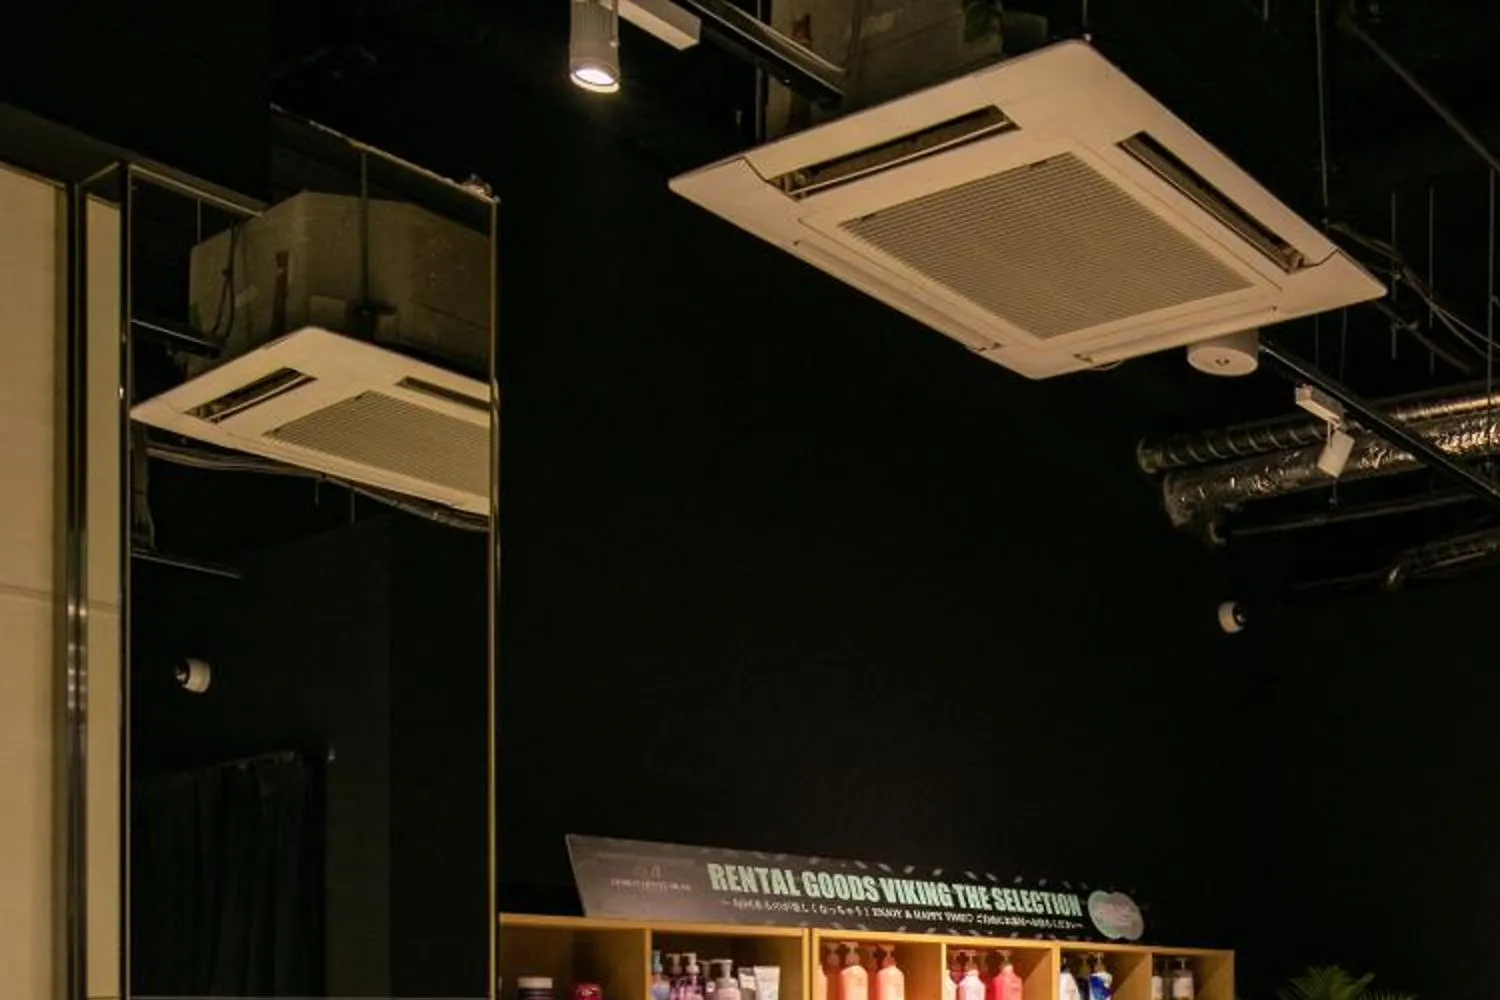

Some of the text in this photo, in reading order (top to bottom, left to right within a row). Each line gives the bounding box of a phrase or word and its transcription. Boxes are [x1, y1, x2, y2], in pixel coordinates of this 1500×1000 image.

[707, 863, 801, 897] RENTAL
[801, 870, 881, 903] GOODS
[878, 877, 954, 908] VIKING
[952, 883, 993, 911] THE
[992, 888, 1083, 917] SELECTION
